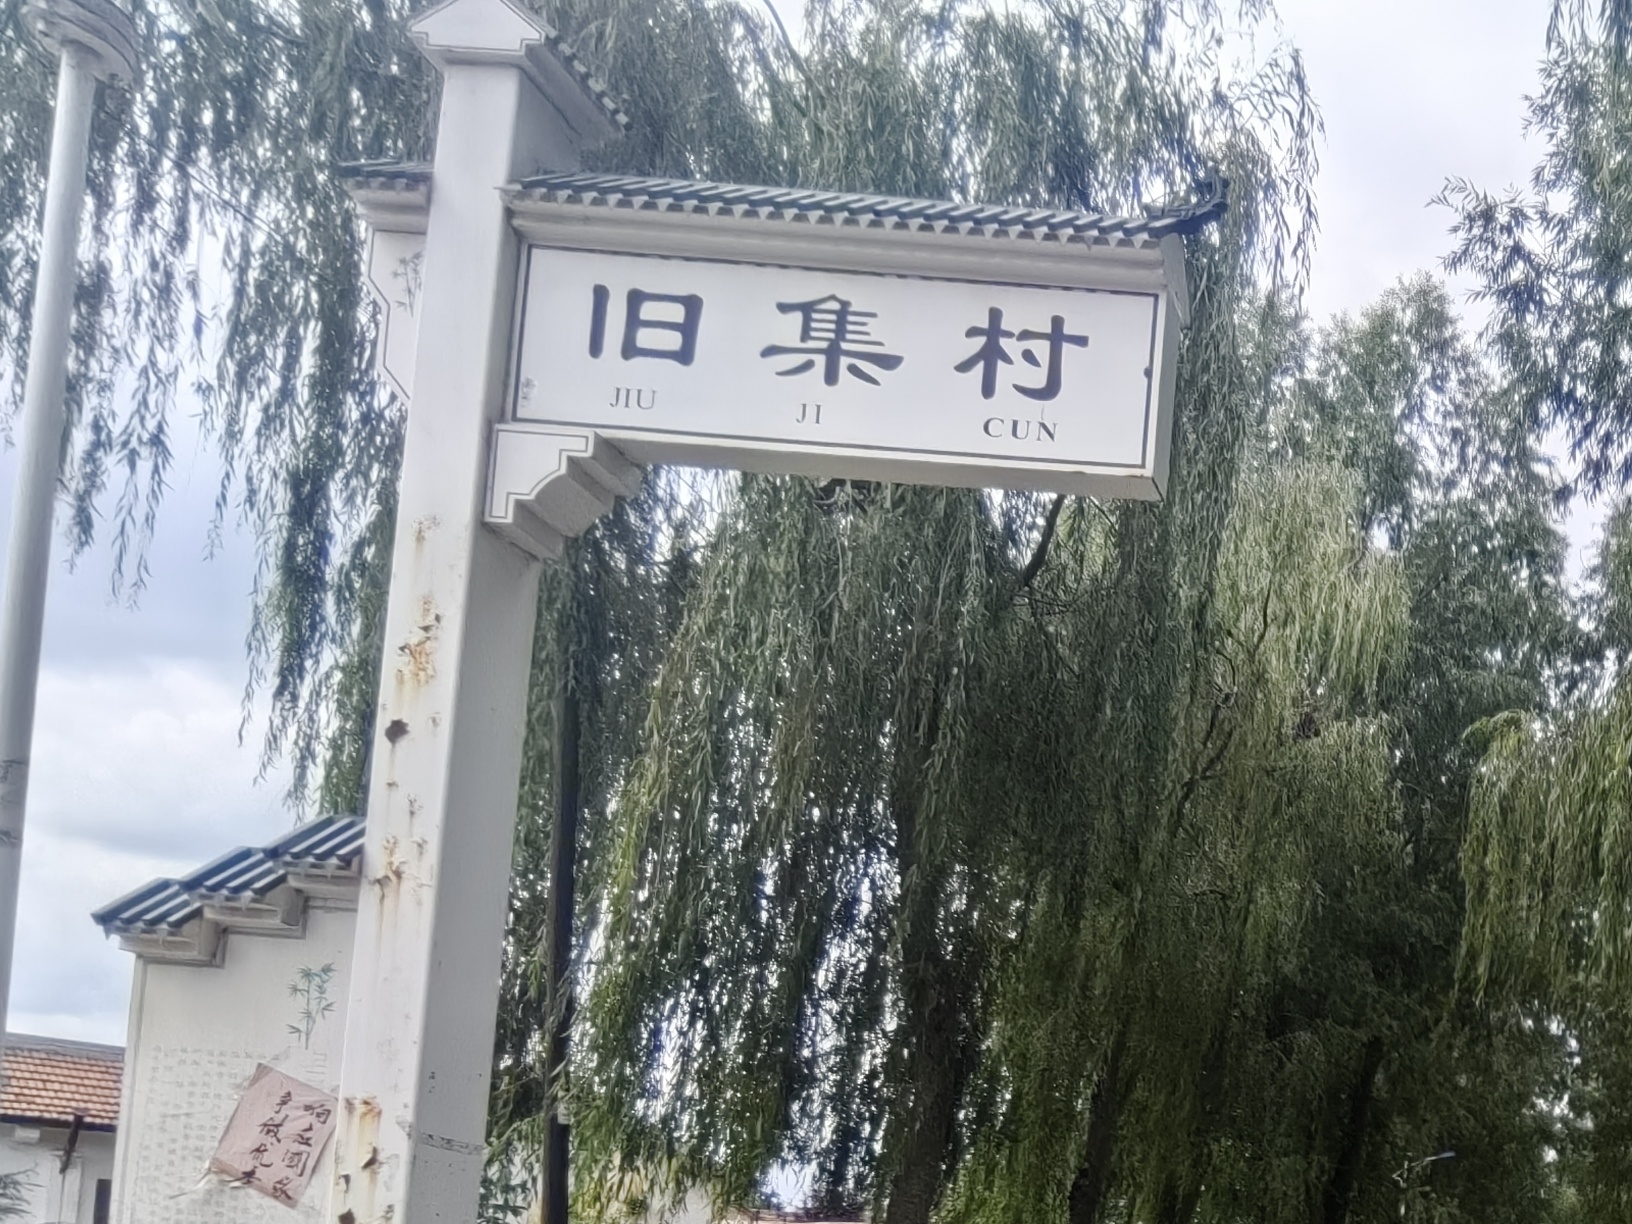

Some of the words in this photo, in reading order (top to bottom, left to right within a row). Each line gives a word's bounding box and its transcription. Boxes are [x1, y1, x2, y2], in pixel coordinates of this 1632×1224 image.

[588, 283, 1090, 401] 旧集村
[609, 386, 658, 410] JIU
[795, 402, 823, 425] JI
[982, 417, 1059, 442] CUN
